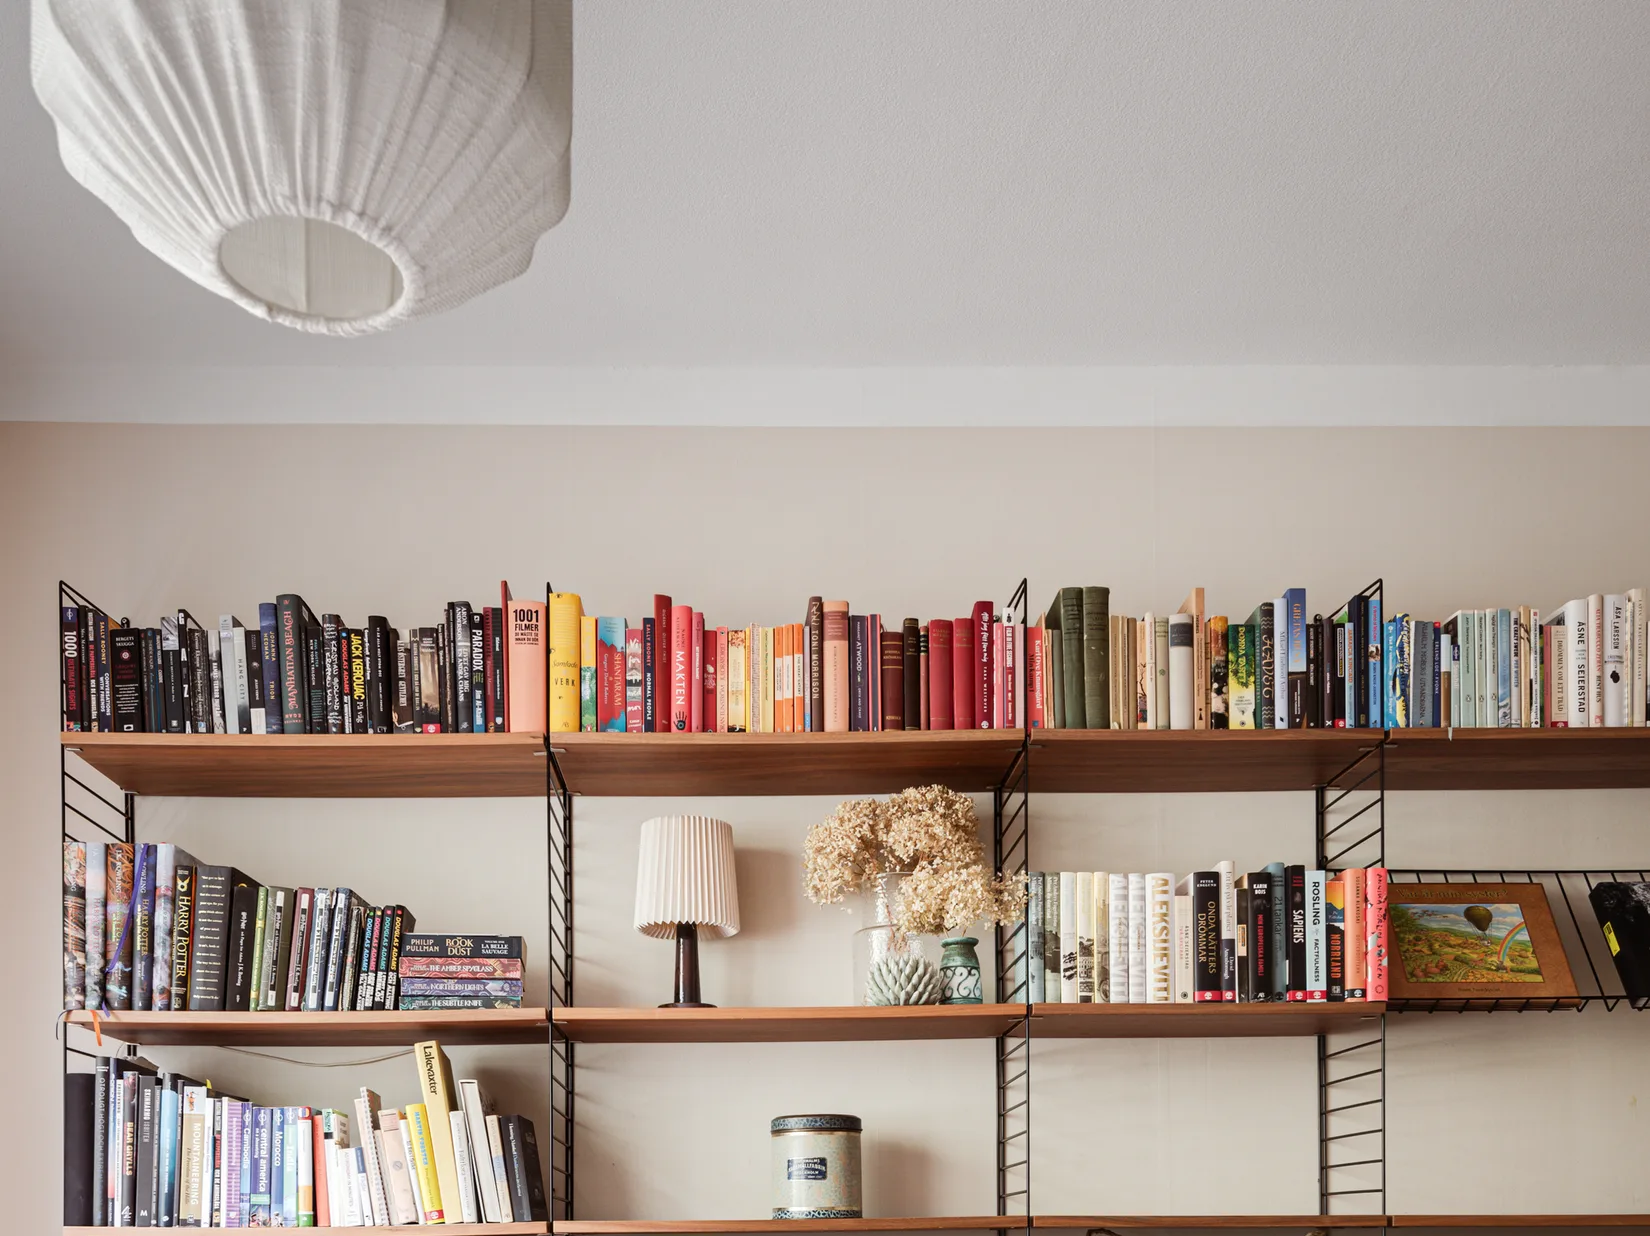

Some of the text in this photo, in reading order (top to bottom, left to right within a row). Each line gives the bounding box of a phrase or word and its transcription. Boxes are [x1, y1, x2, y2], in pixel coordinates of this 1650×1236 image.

[513, 608, 539, 623] 1001
[515, 623, 539, 631] FILMER
[1292, 603, 1301, 639] GRETAS
[284, 611, 298, 710] MANHATTAN BEACH
[458, 648, 463, 657] EN
[472, 629, 483, 671] PARADOX
[65, 631, 77, 710] 1000 ULTIMATE SIGHTS
[350, 634, 365, 700] JACK KEROUAC
[555, 678, 575, 686] VERK
[676, 651, 685, 705] MAKTEN
[1238, 656, 1246, 683] TARTT
[1557, 671, 1564, 681] OM
[1577, 621, 1586, 713] ÅSNE SEIERSTAD
[357, 701, 363, 710] På
[1275, 896, 1283, 937] 21 tankar
[1312, 882, 1320, 925] ROSLING
[176, 896, 190, 978] HARRY POTTER
[365, 918, 373, 947] DOUGLAS
[383, 917, 391, 946] DOUGLAS
[393, 917, 401, 946] DOUGLAS
[1198, 913, 1207, 962] DRÖMMAR
[1208, 901, 1217, 974] ONDA NÄTTERS
[1224, 912, 1232, 932] planet
[1293, 910, 1304, 943] SAPIENS
[141, 927, 149, 956] POTTER
[446, 938, 474, 947] BOOK
[448, 947, 472, 956] DUST
[1330, 934, 1341, 978] NORRLAND
[143, 1089, 151, 1121] SKINNARMO
[414, 1112, 422, 1135] MARTIN
[125, 1122, 134, 1176] BEAR GRYLLS
[191, 1123, 201, 1205] MOUNTAINEERING
[259, 1128, 268, 1192] central america
